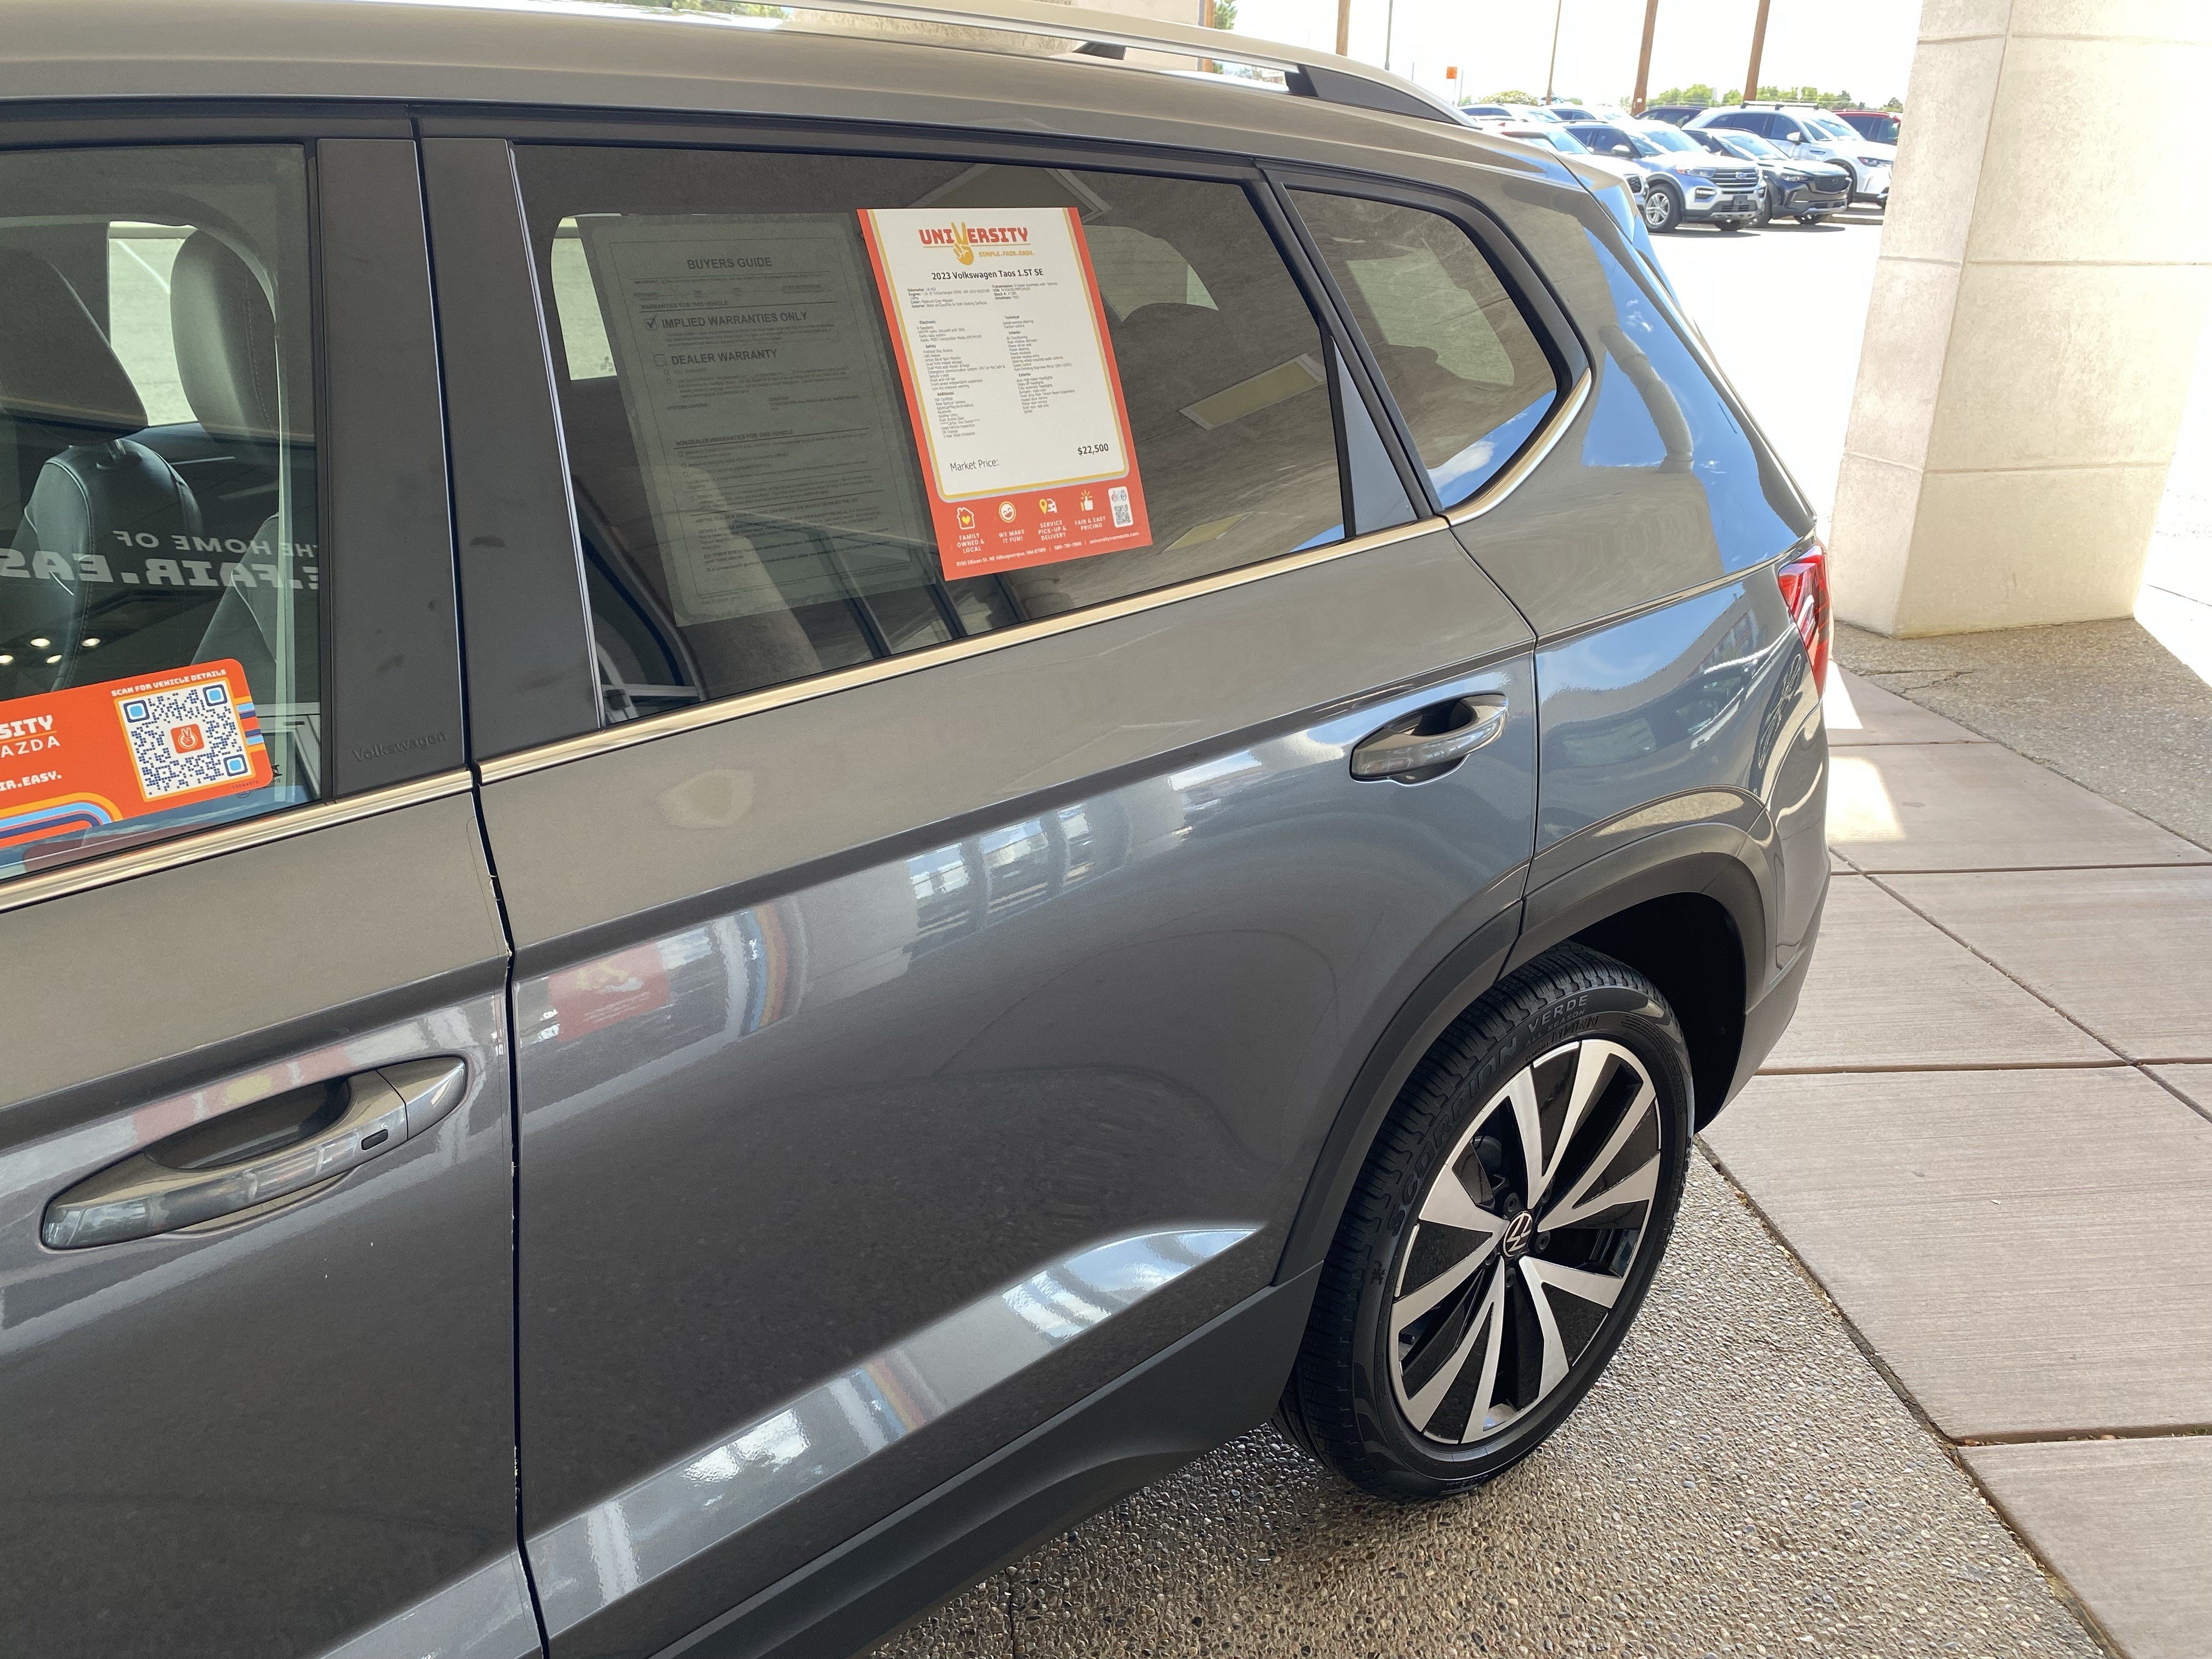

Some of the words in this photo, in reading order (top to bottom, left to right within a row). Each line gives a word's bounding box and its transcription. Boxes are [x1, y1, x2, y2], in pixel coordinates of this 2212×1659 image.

[919, 226, 1028, 245] UNIVERSITY
[687, 258, 735, 270] BUYERS
[738, 257, 772, 268] GUIDE
[932, 272, 951, 280] 2023
[662, 317, 705, 328] IMPLIED
[708, 313, 777, 325] WARRANTIES
[780, 311, 806, 321] ONLY
[671, 353, 715, 364] DEALER
[718, 349, 776, 361] WARRANTY
[950, 461, 976, 471] Market
[978, 459, 998, 467] Price:
[1077, 443, 1108, 455] $22,500
[1038, 526, 1060, 534] PICK-UP
[1040, 520, 1062, 528] SERVICE
[956, 539, 978, 548] OWNED
[1041, 532, 1065, 540] DELIVERY
[111, 687, 134, 697] SCAN
[135, 683, 151, 692] FOR
[153, 675, 190, 689] VEHICLE
[191, 668, 227, 682] DETAILS
[0, 714, 53, 740] SITY
[1, 735, 61, 758] AZDA
[352, 731, 447, 761] Volkswagen
[1525, 1031, 1543, 1047] ALL
[1547, 1009, 1585, 1032] SEASON
[1388, 1035, 1518, 1239] SCORPION
[1528, 994, 1588, 1033] VERDE
